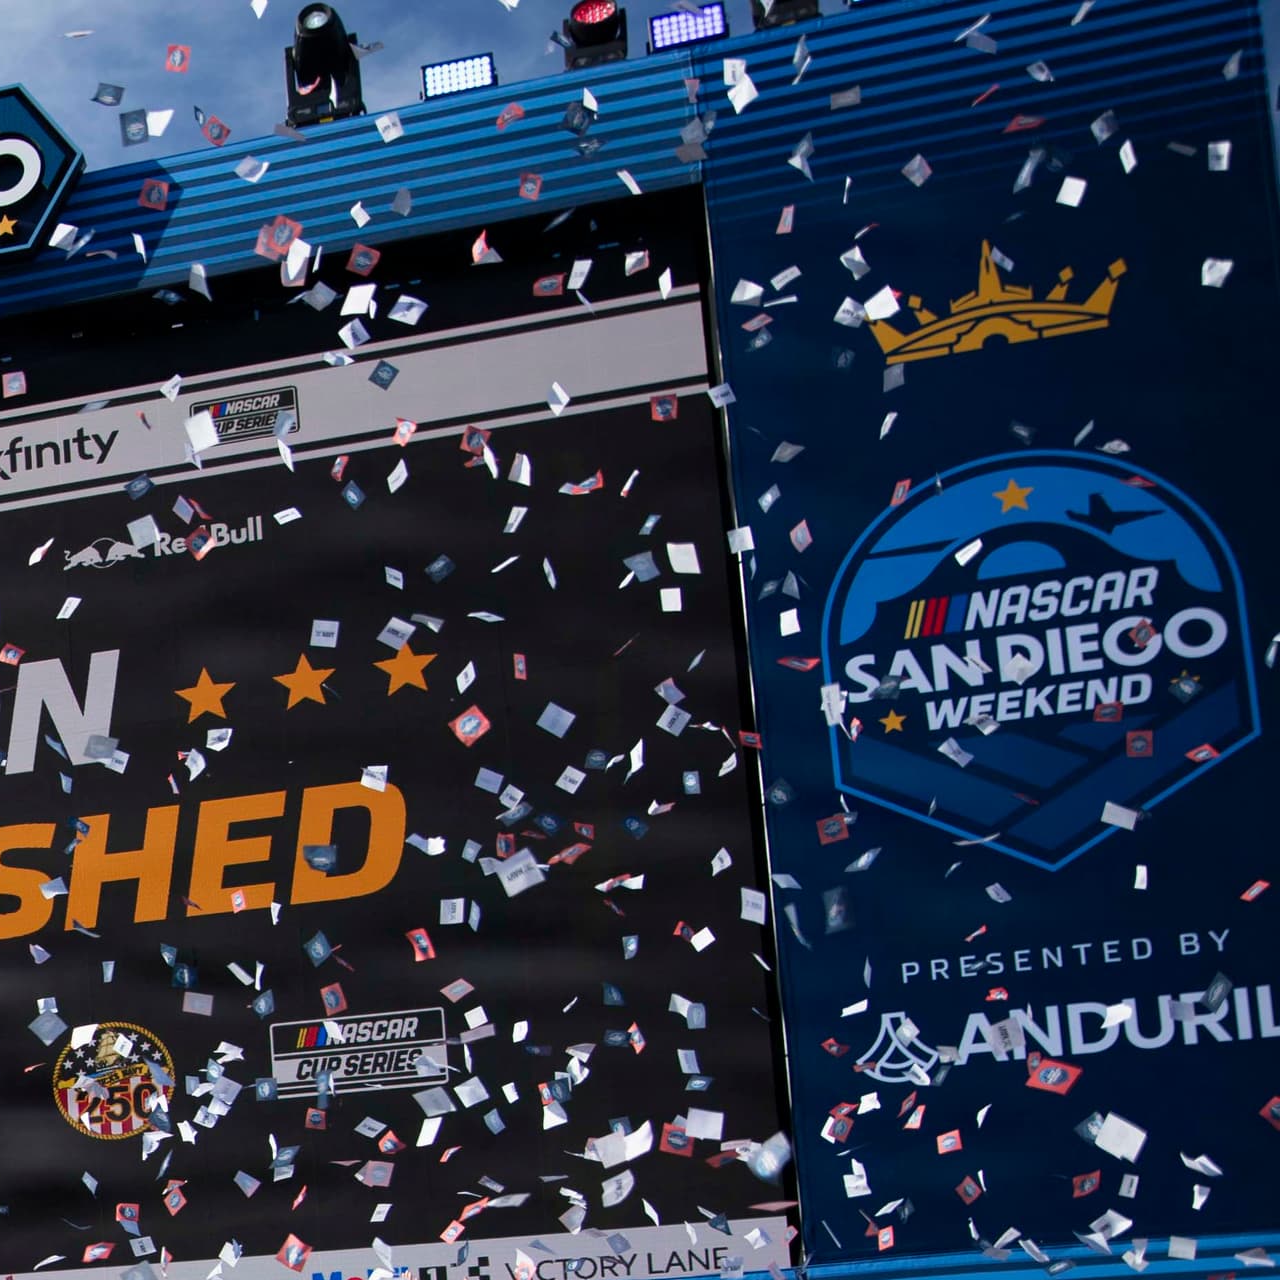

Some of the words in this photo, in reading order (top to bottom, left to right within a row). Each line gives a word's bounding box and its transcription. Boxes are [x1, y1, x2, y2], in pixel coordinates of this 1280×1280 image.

[225, 394, 280, 416] NASCAR
[154, 525, 208, 557] Re
[211, 516, 263, 548] Bull
[965, 566, 1160, 632] NASCAR
[844, 640, 985, 703] SAN
[996, 606, 1228, 684] DIEGO
[925, 674, 1153, 732] WEEKEND
[901, 937, 1153, 984] PRESENTED
[1179, 929, 1230, 957] BY
[954, 984, 1280, 1066] ANDURIL
[296, 1056, 342, 1081] CUP
[343, 1048, 423, 1077] SERIES
[648, 1246, 730, 1274] LANE
